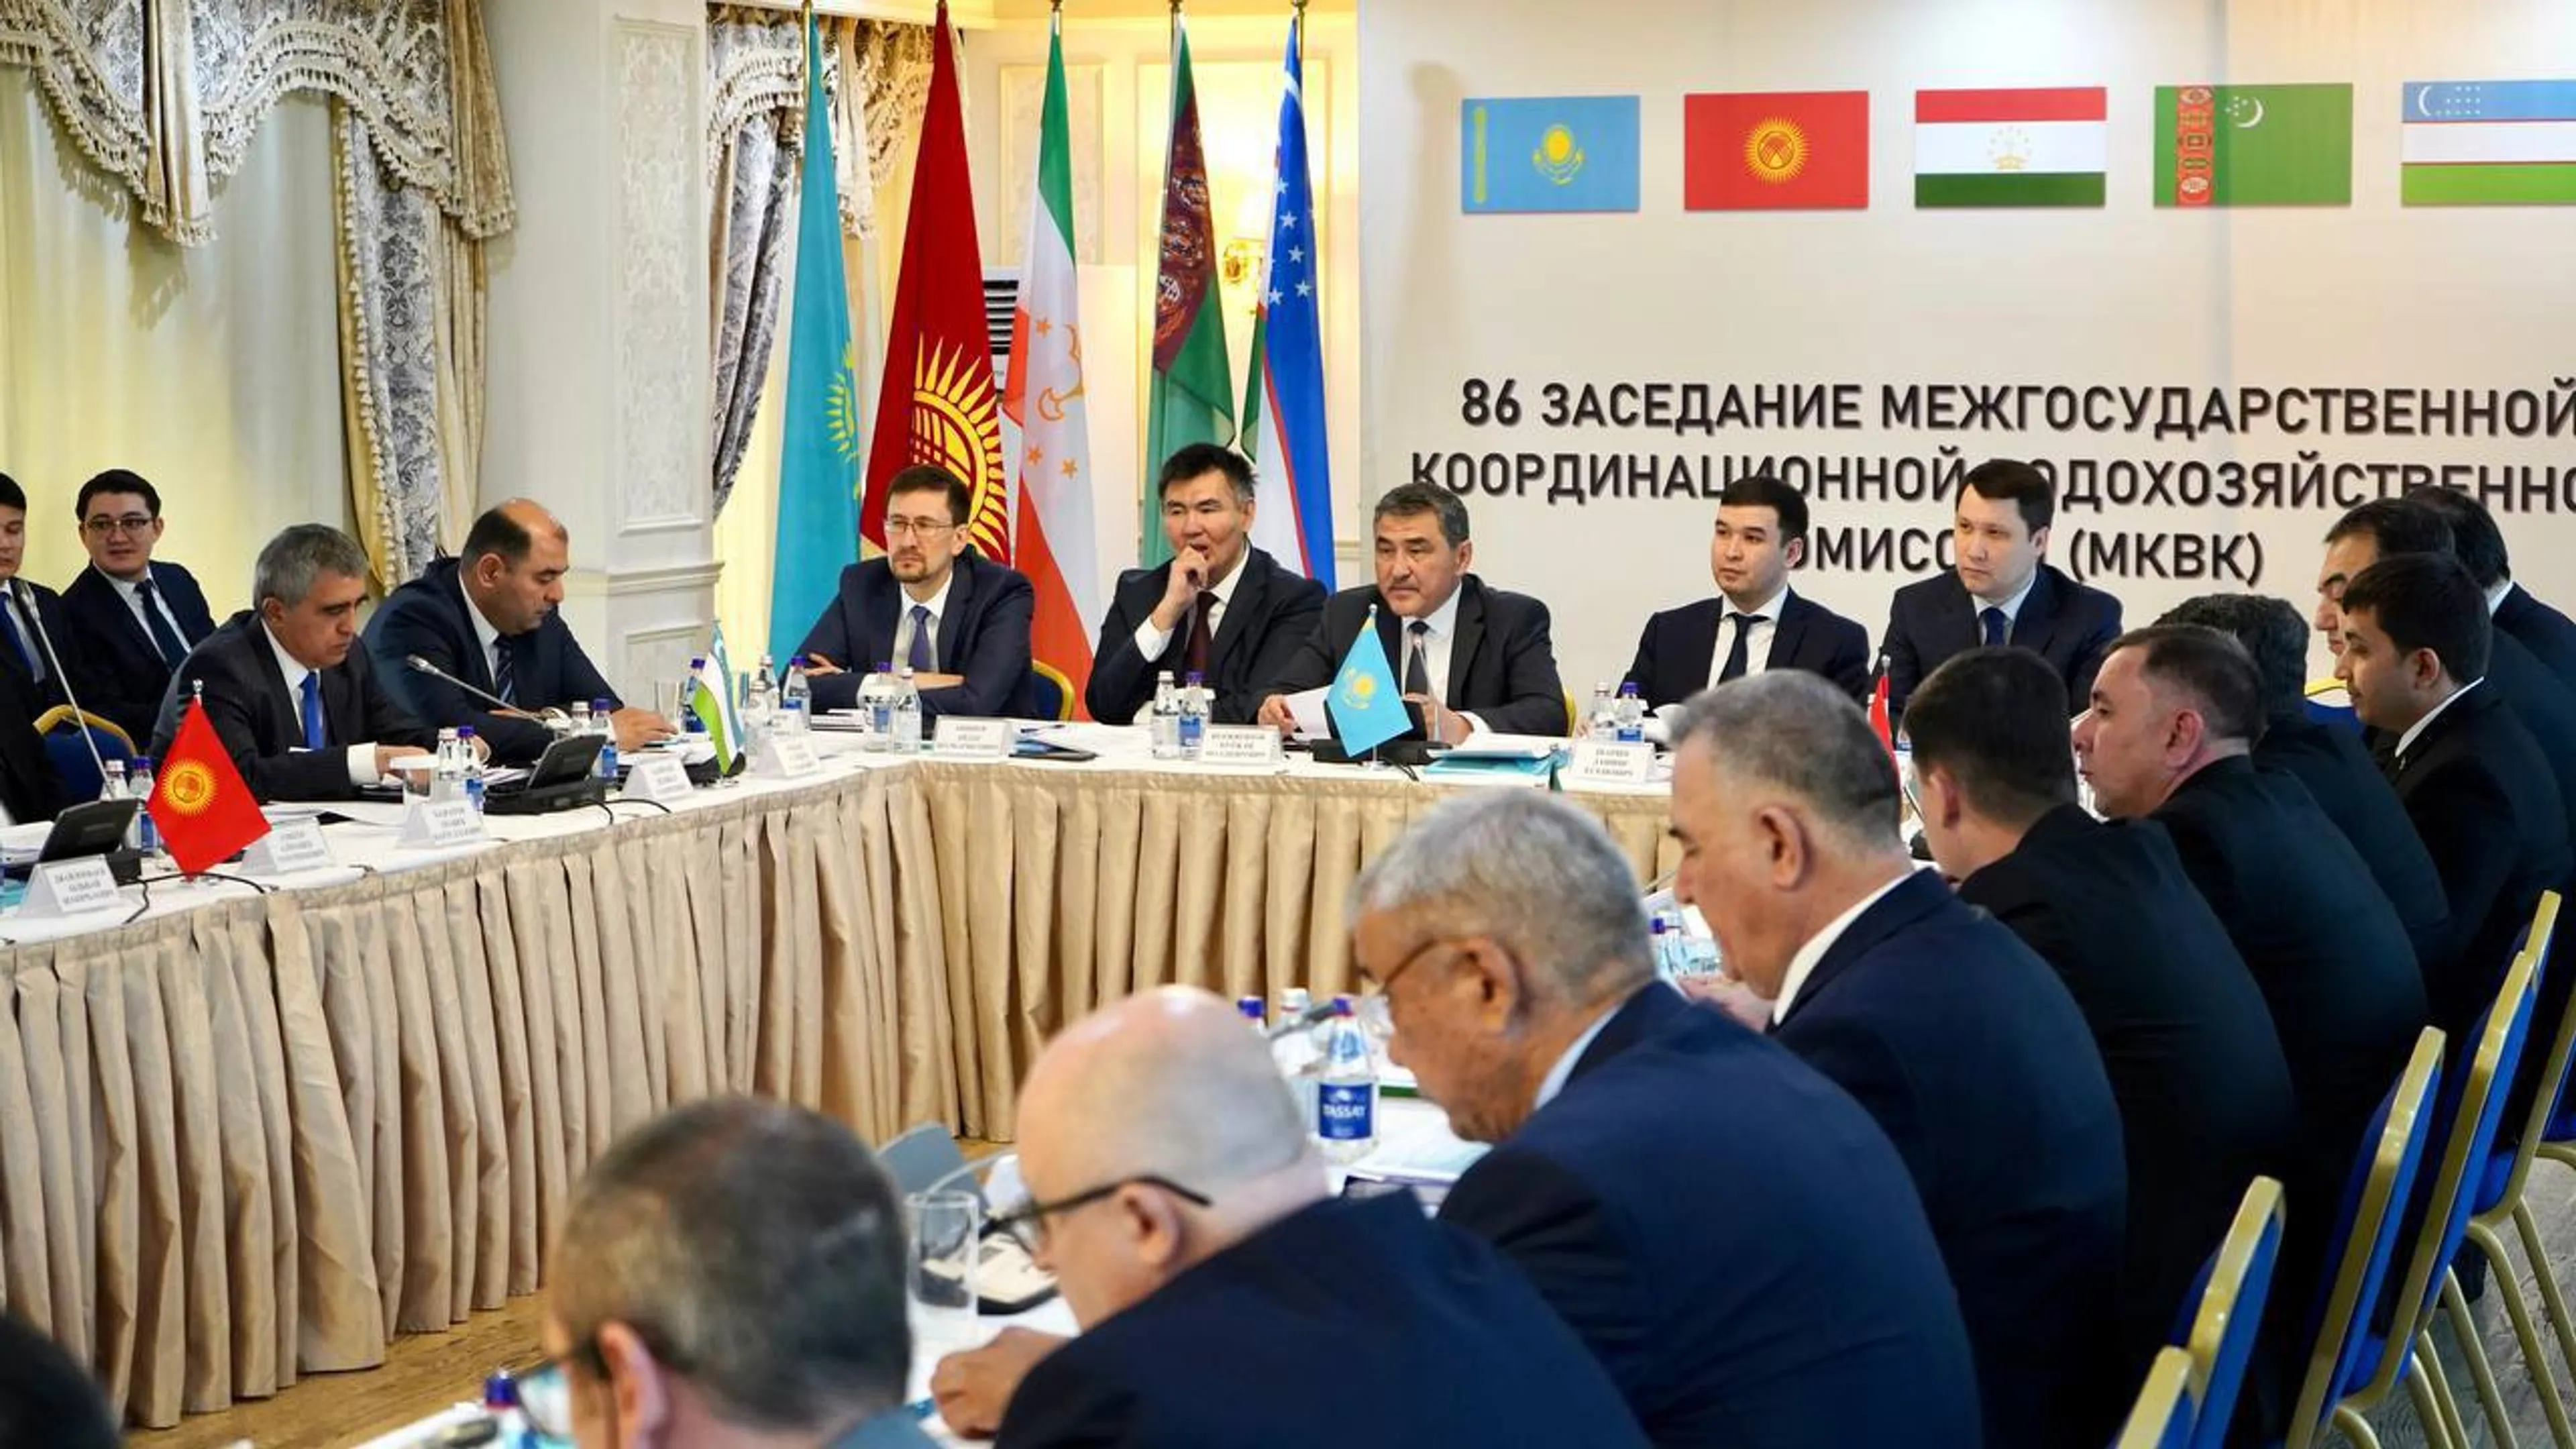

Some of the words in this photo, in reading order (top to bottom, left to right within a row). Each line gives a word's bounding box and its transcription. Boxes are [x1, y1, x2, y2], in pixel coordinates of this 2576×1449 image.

[1462, 378, 1521, 427] 86
[1542, 383, 1862, 436] ЗАСЕДАНИЕ
[1882, 377, 2576, 441] МЕЖГОСУДАРСТВЕННОЙ
[2031, 450, 2576, 514] ДОХОЗЯЙСТВЕНН
[2070, 529, 2263, 588] (МКВК)
